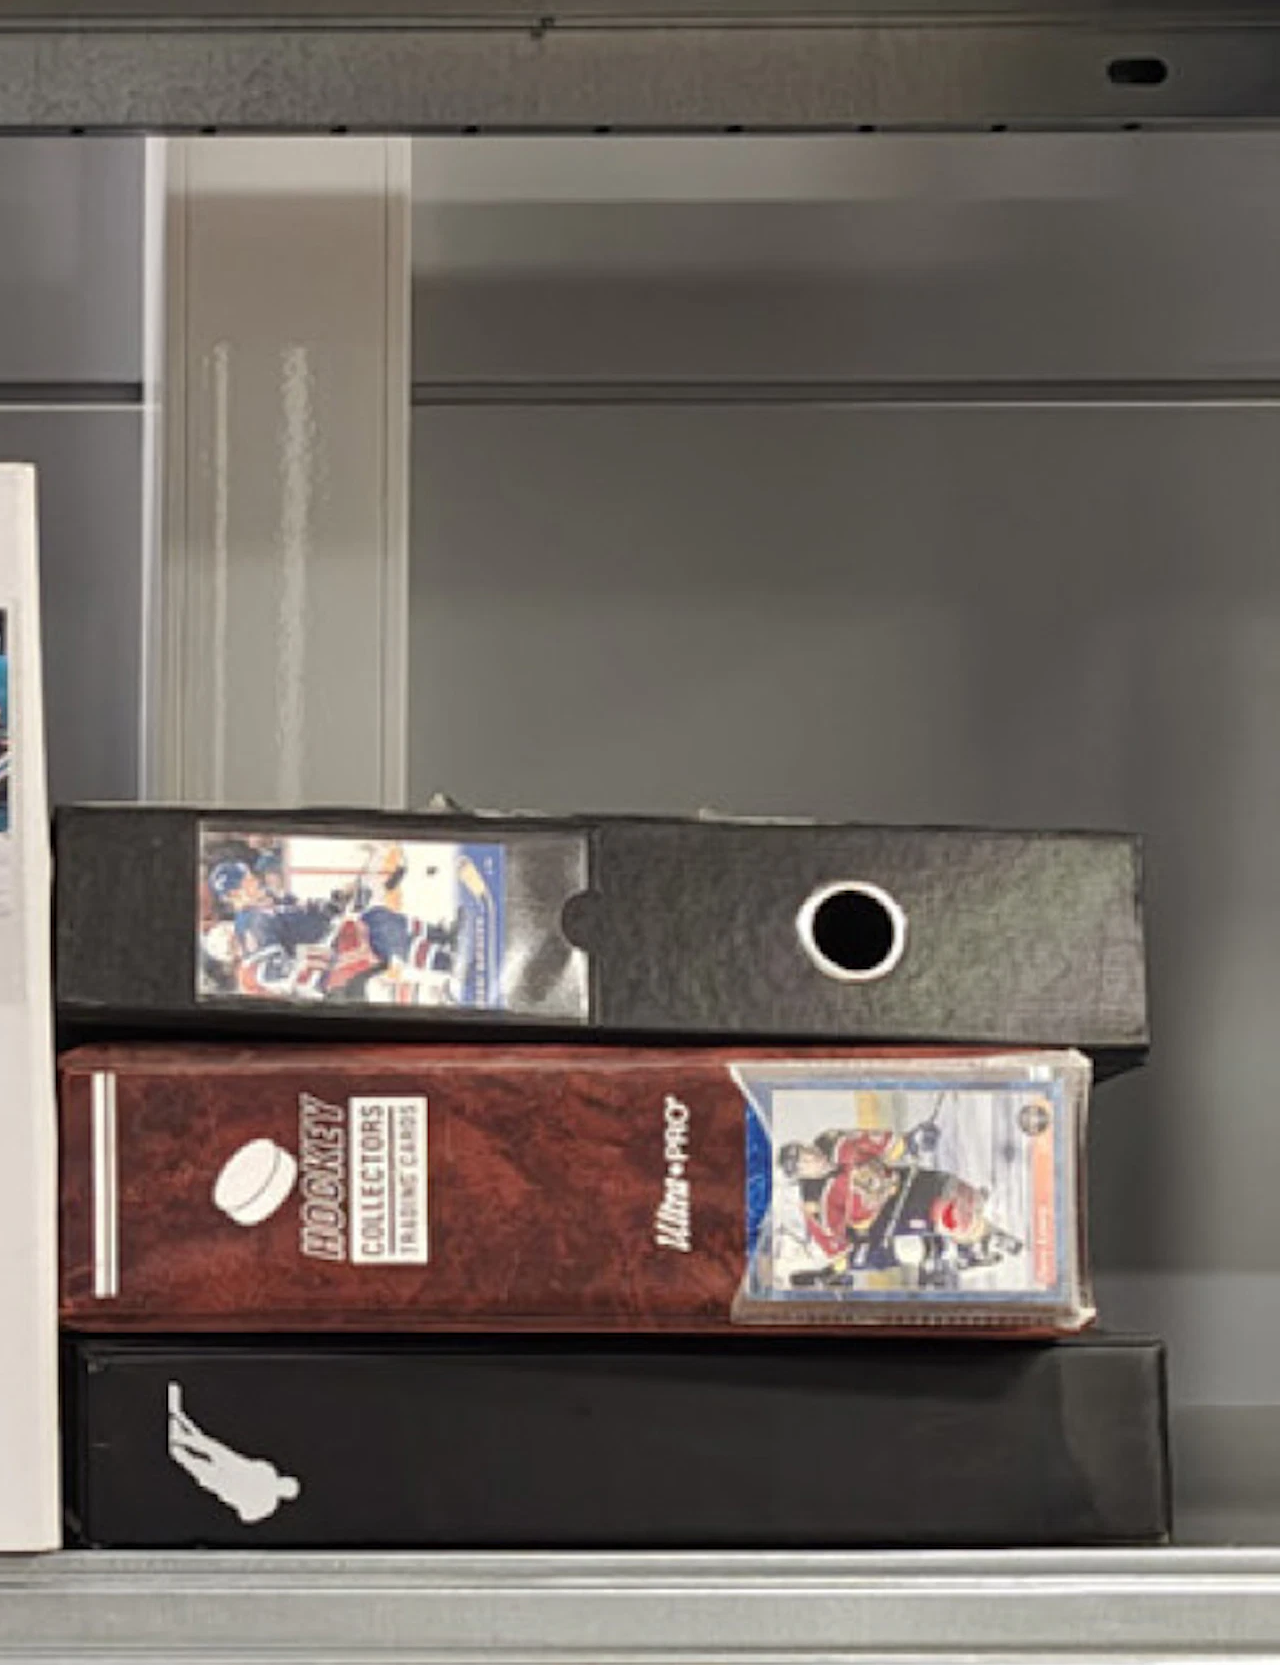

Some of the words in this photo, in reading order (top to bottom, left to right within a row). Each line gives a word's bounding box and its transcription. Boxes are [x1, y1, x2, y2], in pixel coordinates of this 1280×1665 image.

[298, 1092, 345, 1261] HOCKEY
[360, 1103, 385, 1257] COLLECTORS
[398, 1103, 419, 1167] CARDS
[398, 1173, 419, 1255] TRADING
